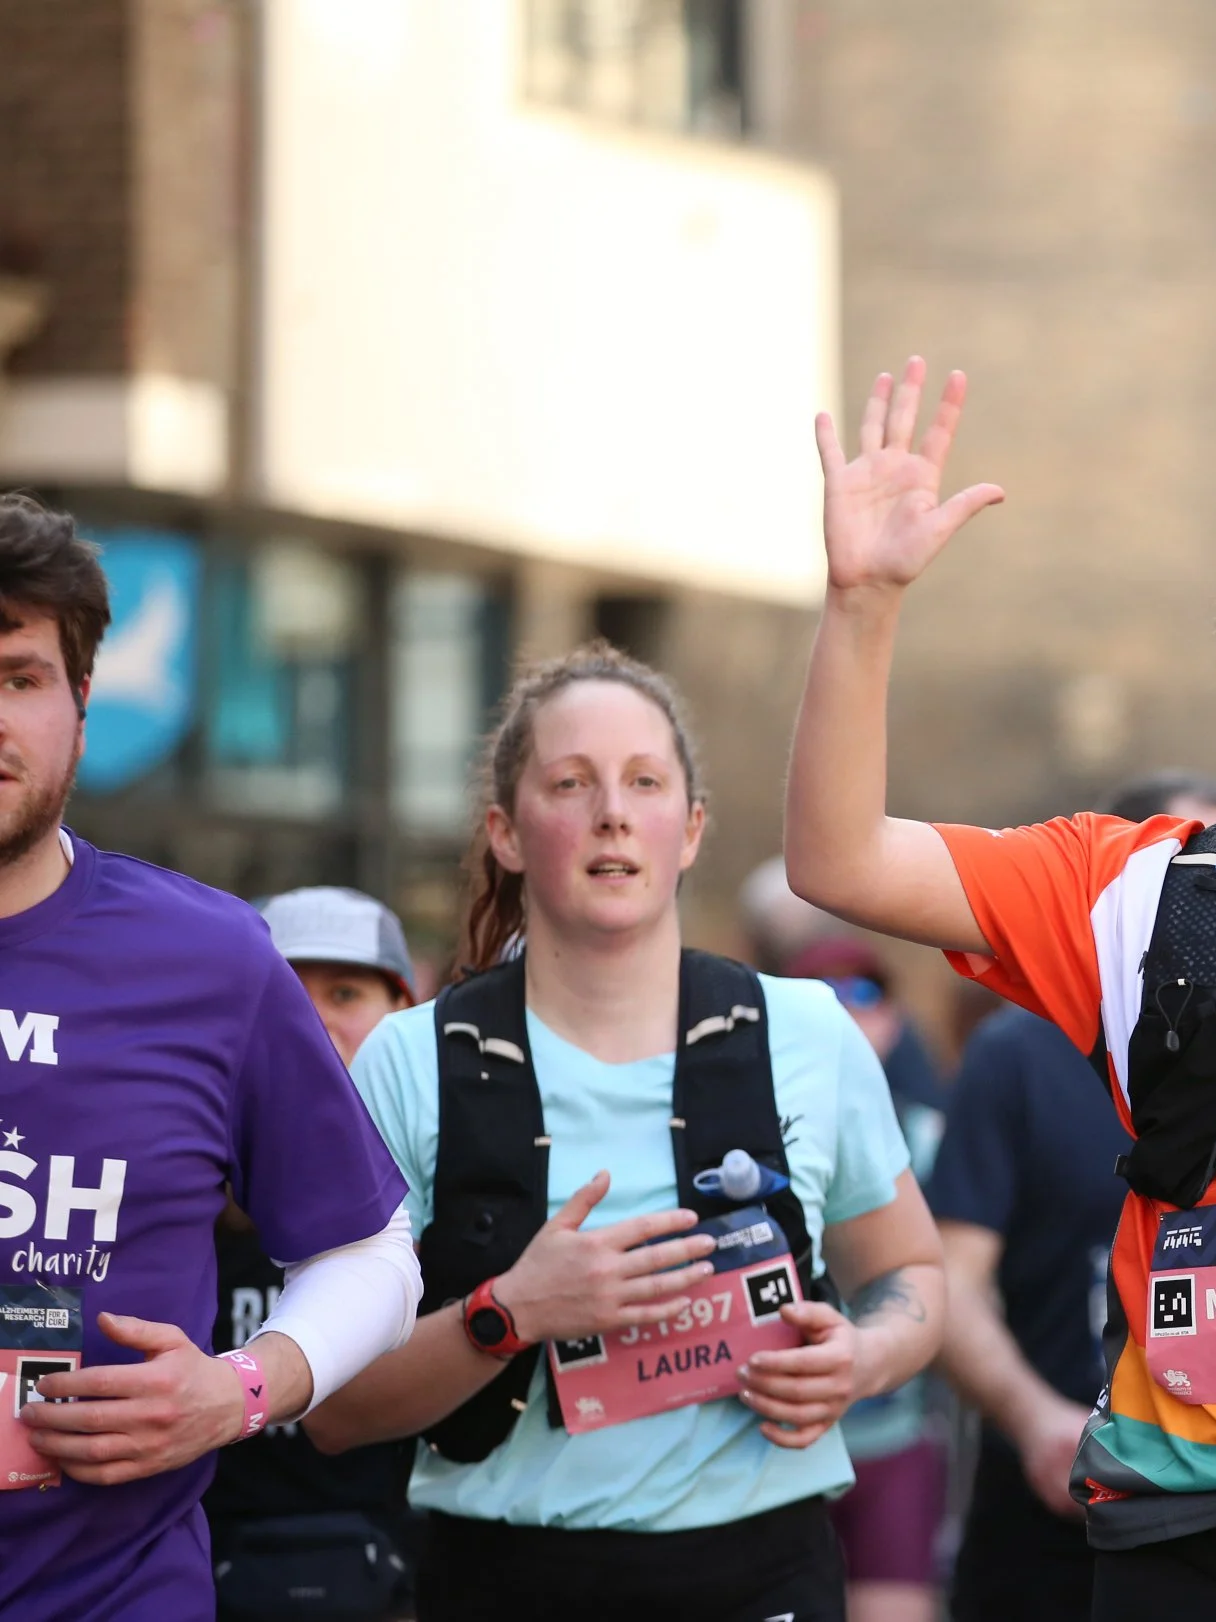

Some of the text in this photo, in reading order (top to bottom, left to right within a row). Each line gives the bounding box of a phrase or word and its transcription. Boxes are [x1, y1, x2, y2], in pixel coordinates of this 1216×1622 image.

[12, 1241, 111, 1283] charity
[48, 1318, 66, 1326] CURE
[637, 1340, 733, 1383] LAURA
